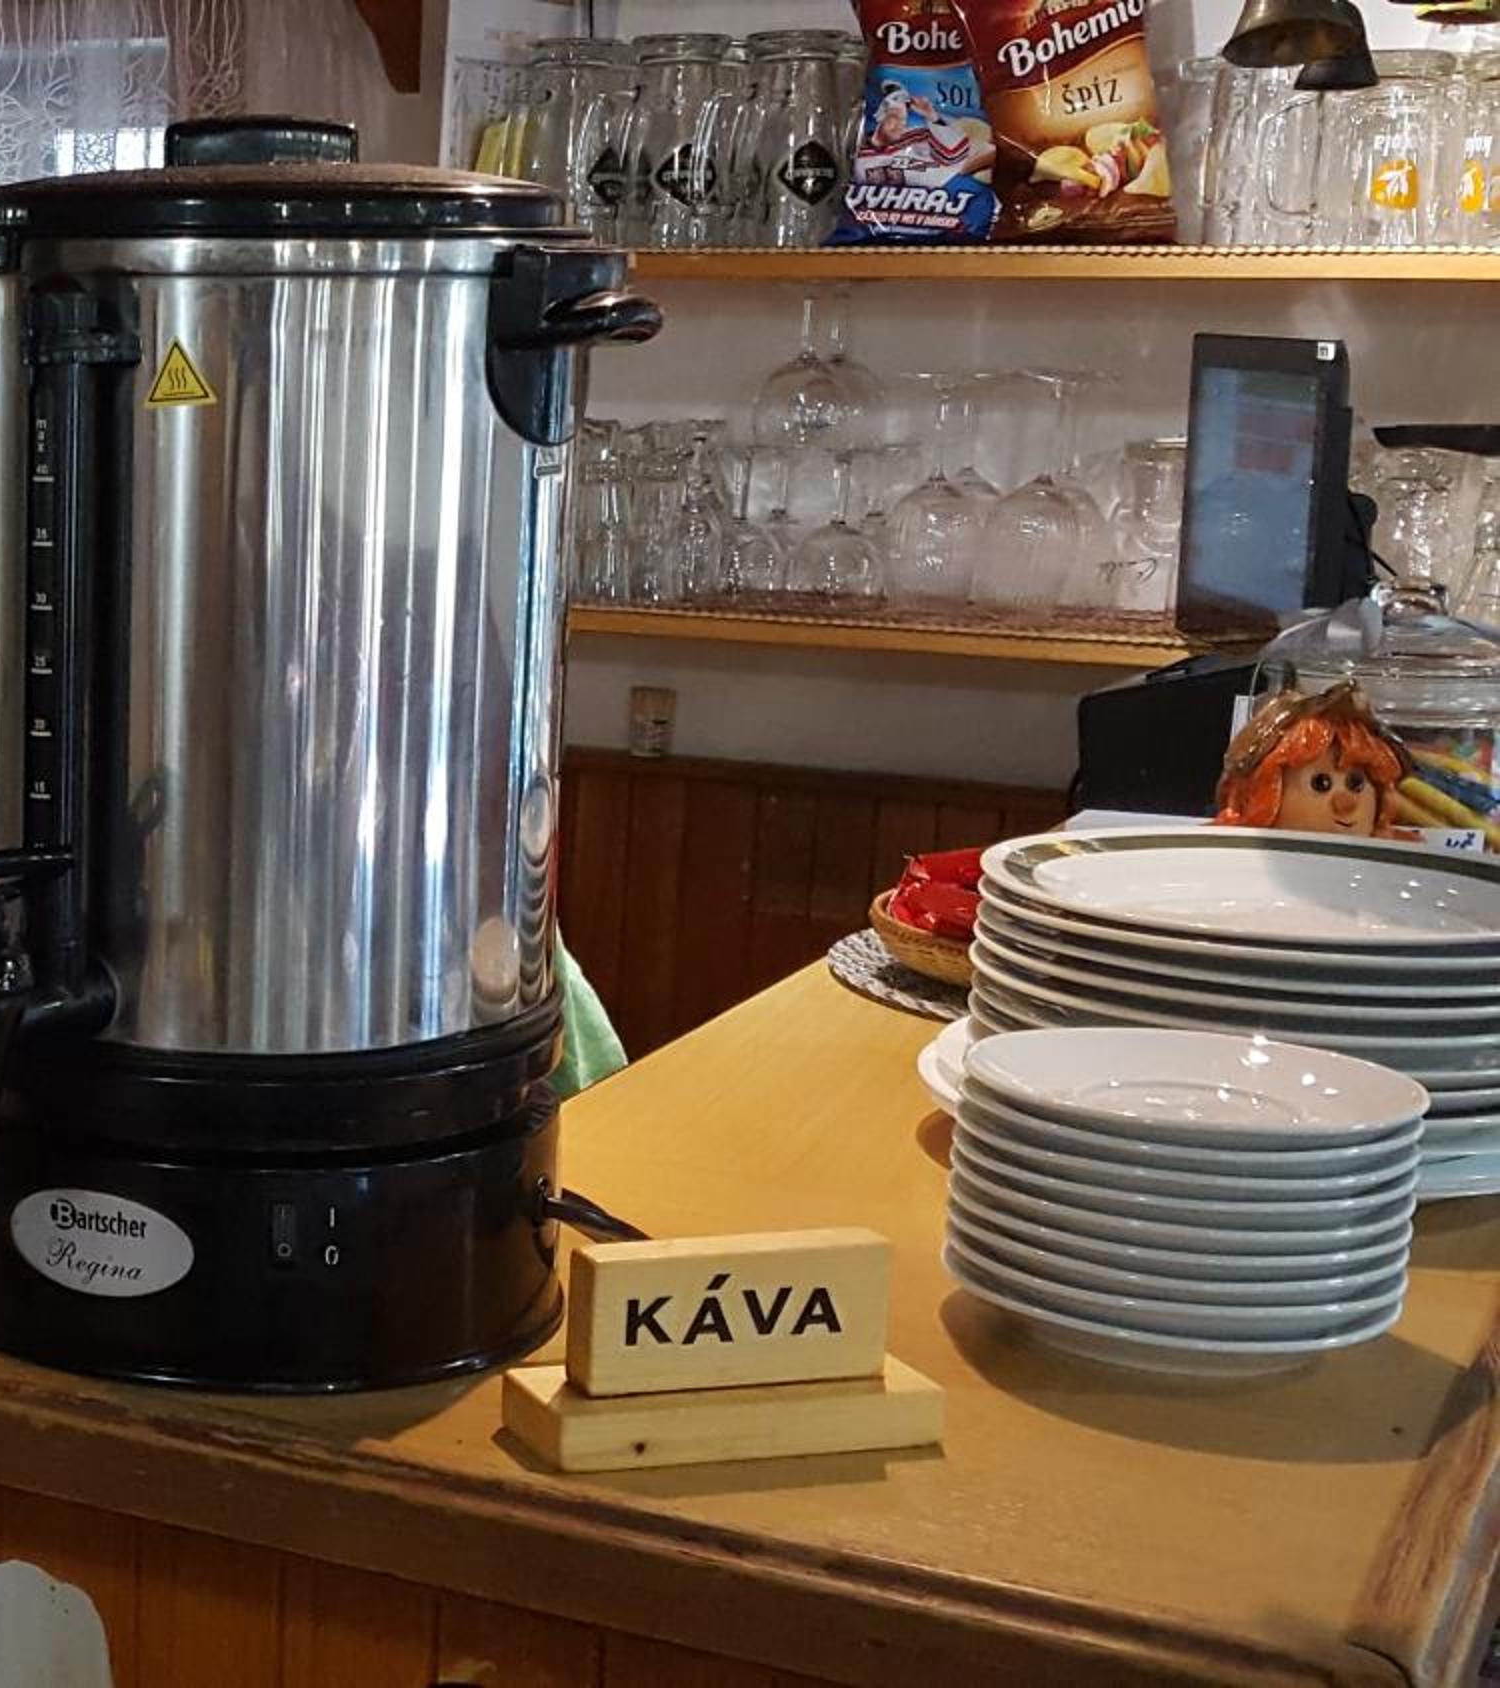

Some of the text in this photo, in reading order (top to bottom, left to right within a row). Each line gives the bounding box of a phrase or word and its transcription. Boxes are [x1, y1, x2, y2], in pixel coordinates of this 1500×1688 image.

[1061, 76, 1123, 115] ŠPÍZ
[50, 1199, 147, 1239] Bartscher
[46, 1237, 144, 1285] Regina
[624, 1272, 843, 1347] KÁVA
